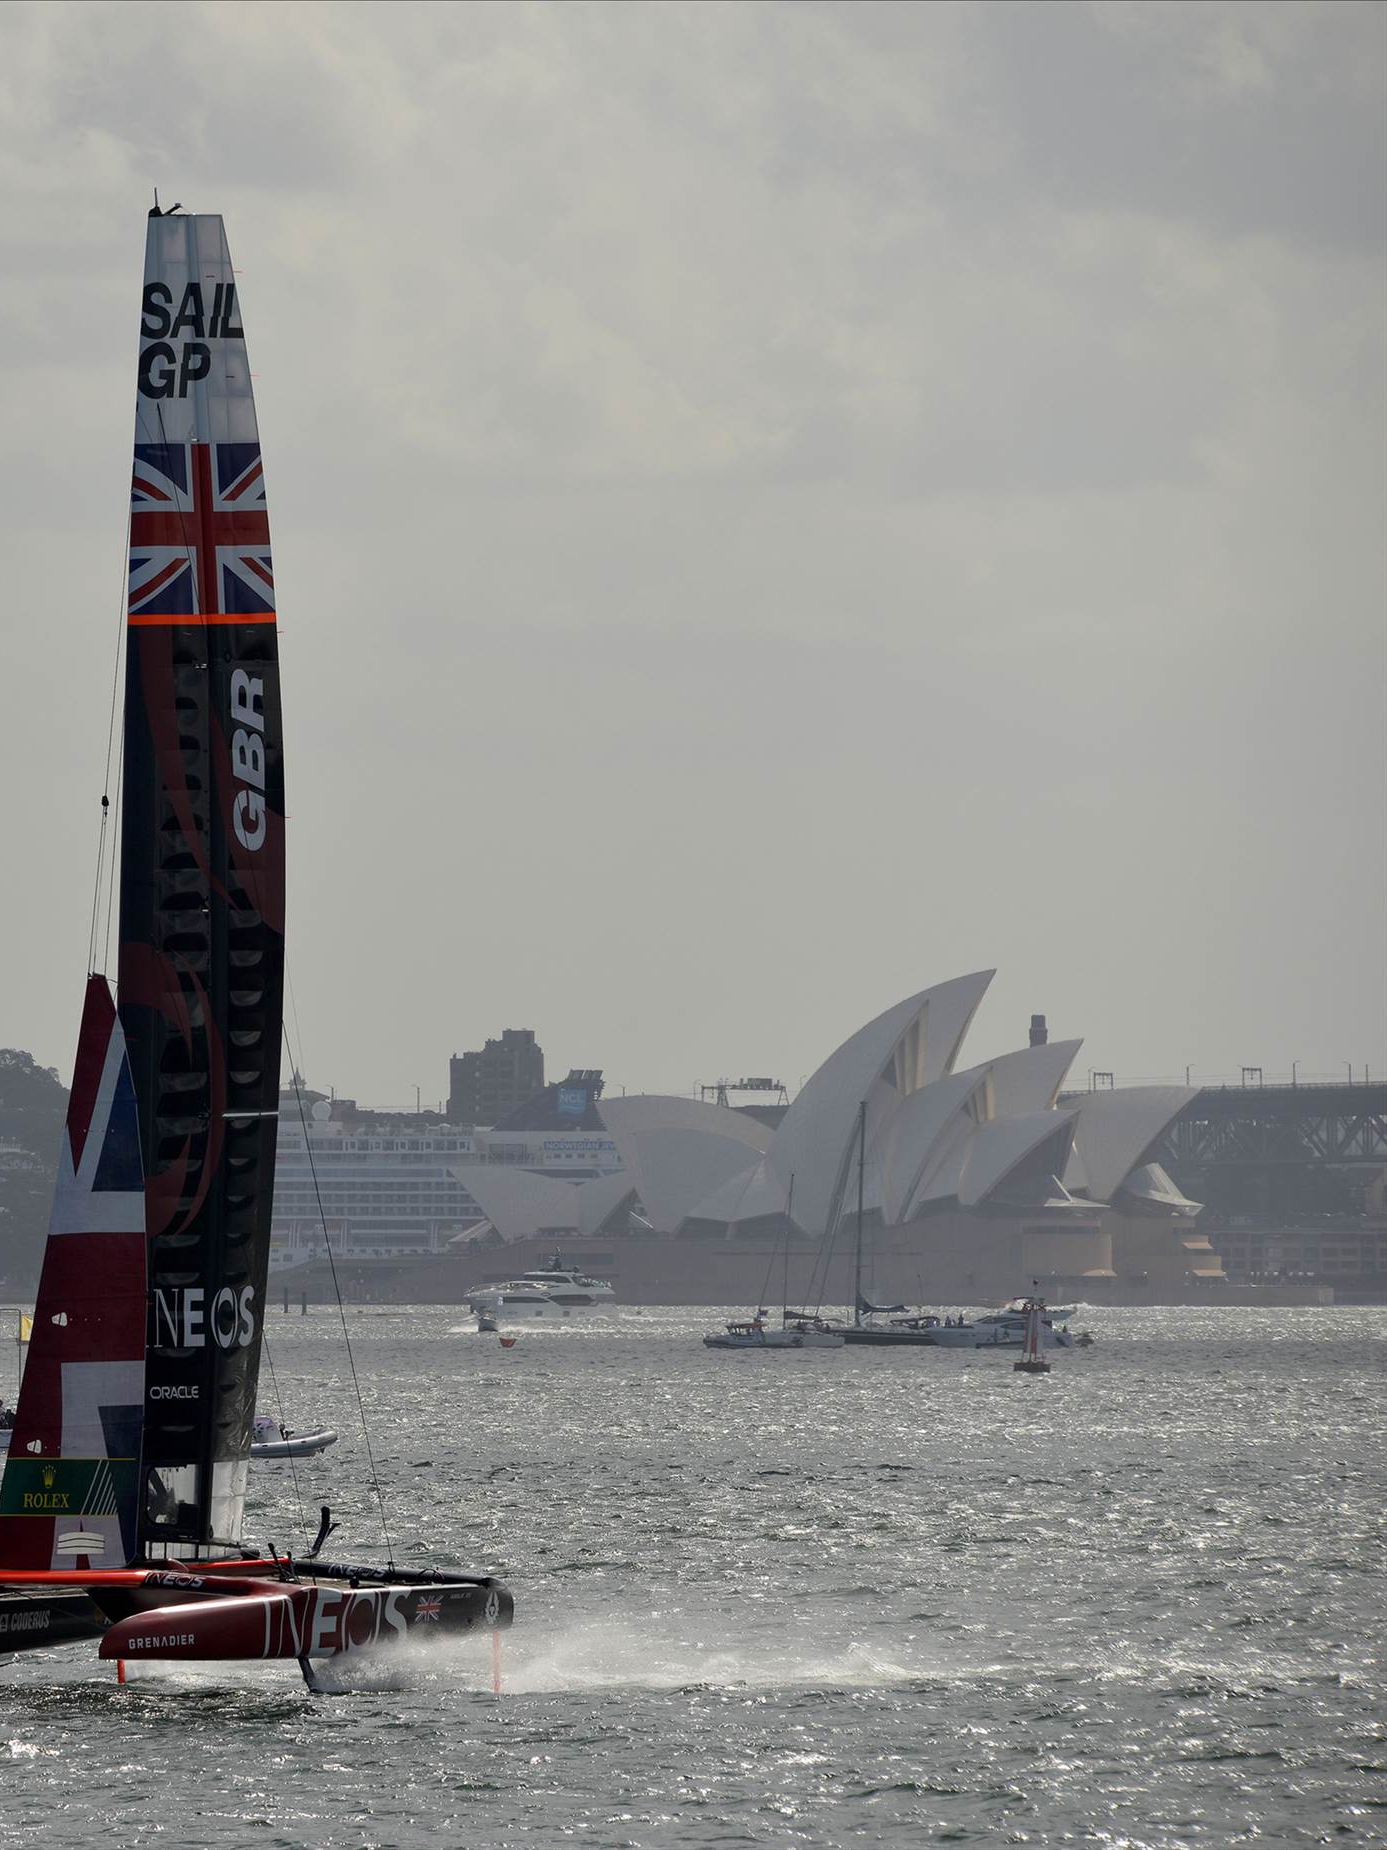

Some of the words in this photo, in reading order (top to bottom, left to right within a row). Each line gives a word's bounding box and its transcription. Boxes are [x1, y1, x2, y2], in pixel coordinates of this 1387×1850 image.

[140, 282, 245, 340] SAIL
[137, 341, 212, 400] GP
[231, 668, 267, 851] GBR
[559, 1093, 582, 1104] NCL
[546, 1142, 598, 1150] NORWEGIAN
[146, 1285, 255, 1349] NEOS
[149, 1386, 199, 1399] ORACLE
[23, 1493, 70, 1508] ROLEX
[145, 1571, 206, 1588] INEOS
[262, 1587, 413, 1659] INEOS
[128, 1634, 195, 1650] GRENADIER
